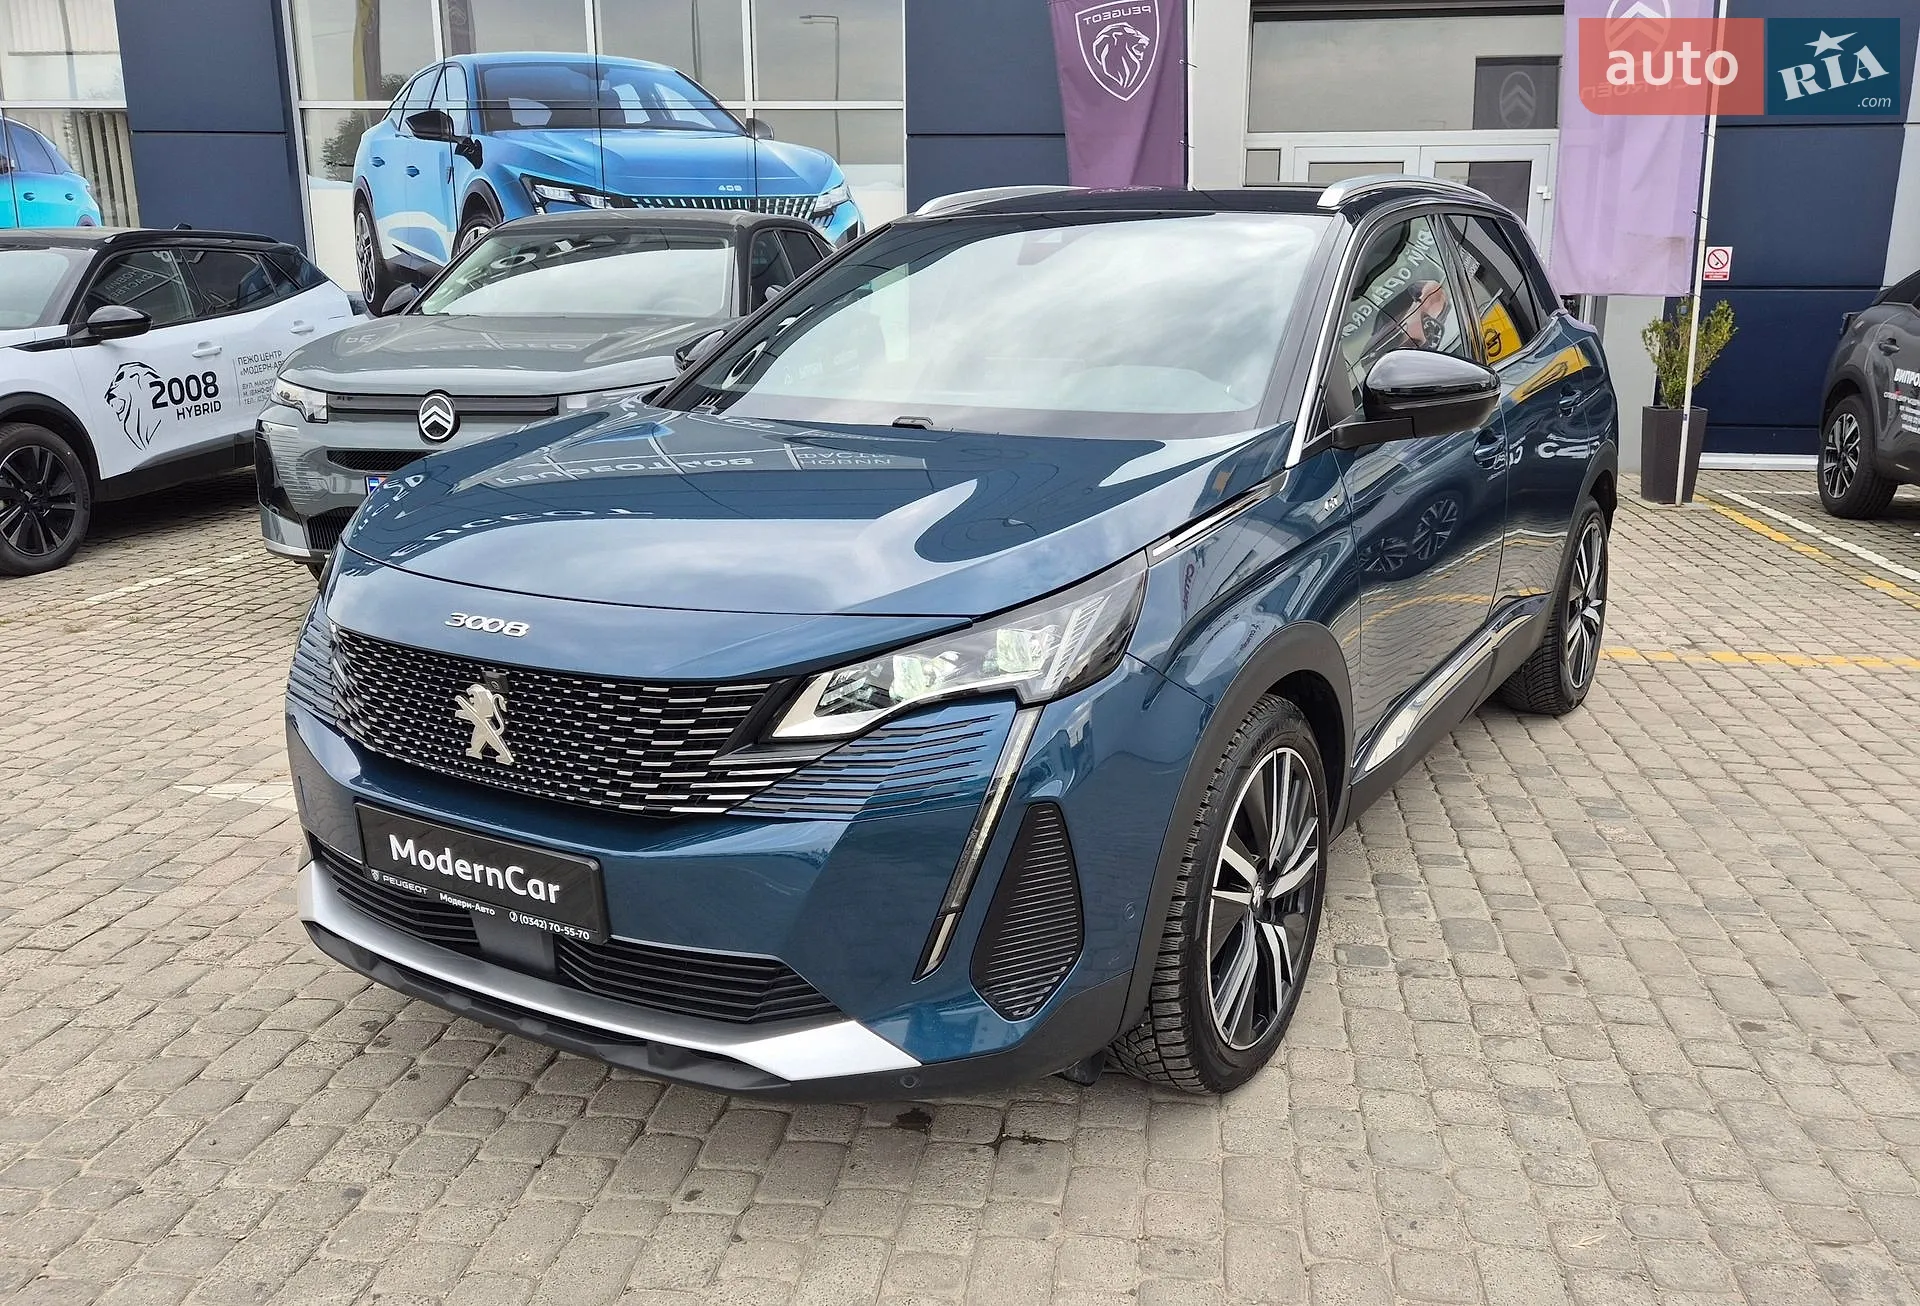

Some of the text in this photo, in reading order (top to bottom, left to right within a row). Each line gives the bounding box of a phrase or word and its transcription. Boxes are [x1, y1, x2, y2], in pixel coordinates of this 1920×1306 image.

[237, 350, 282, 365] ПЕЖО ЦЕНТР
[149, 371, 219, 409] 2008
[176, 400, 222, 421] HYBRID
[444, 612, 530, 637] 3008
[389, 834, 560, 904] ModernCar
[383, 875, 428, 895] PEUGEOT
[439, 892, 496, 916] Модерн-Авто
[519, 914, 590, 940] (0342) 70-55-70
